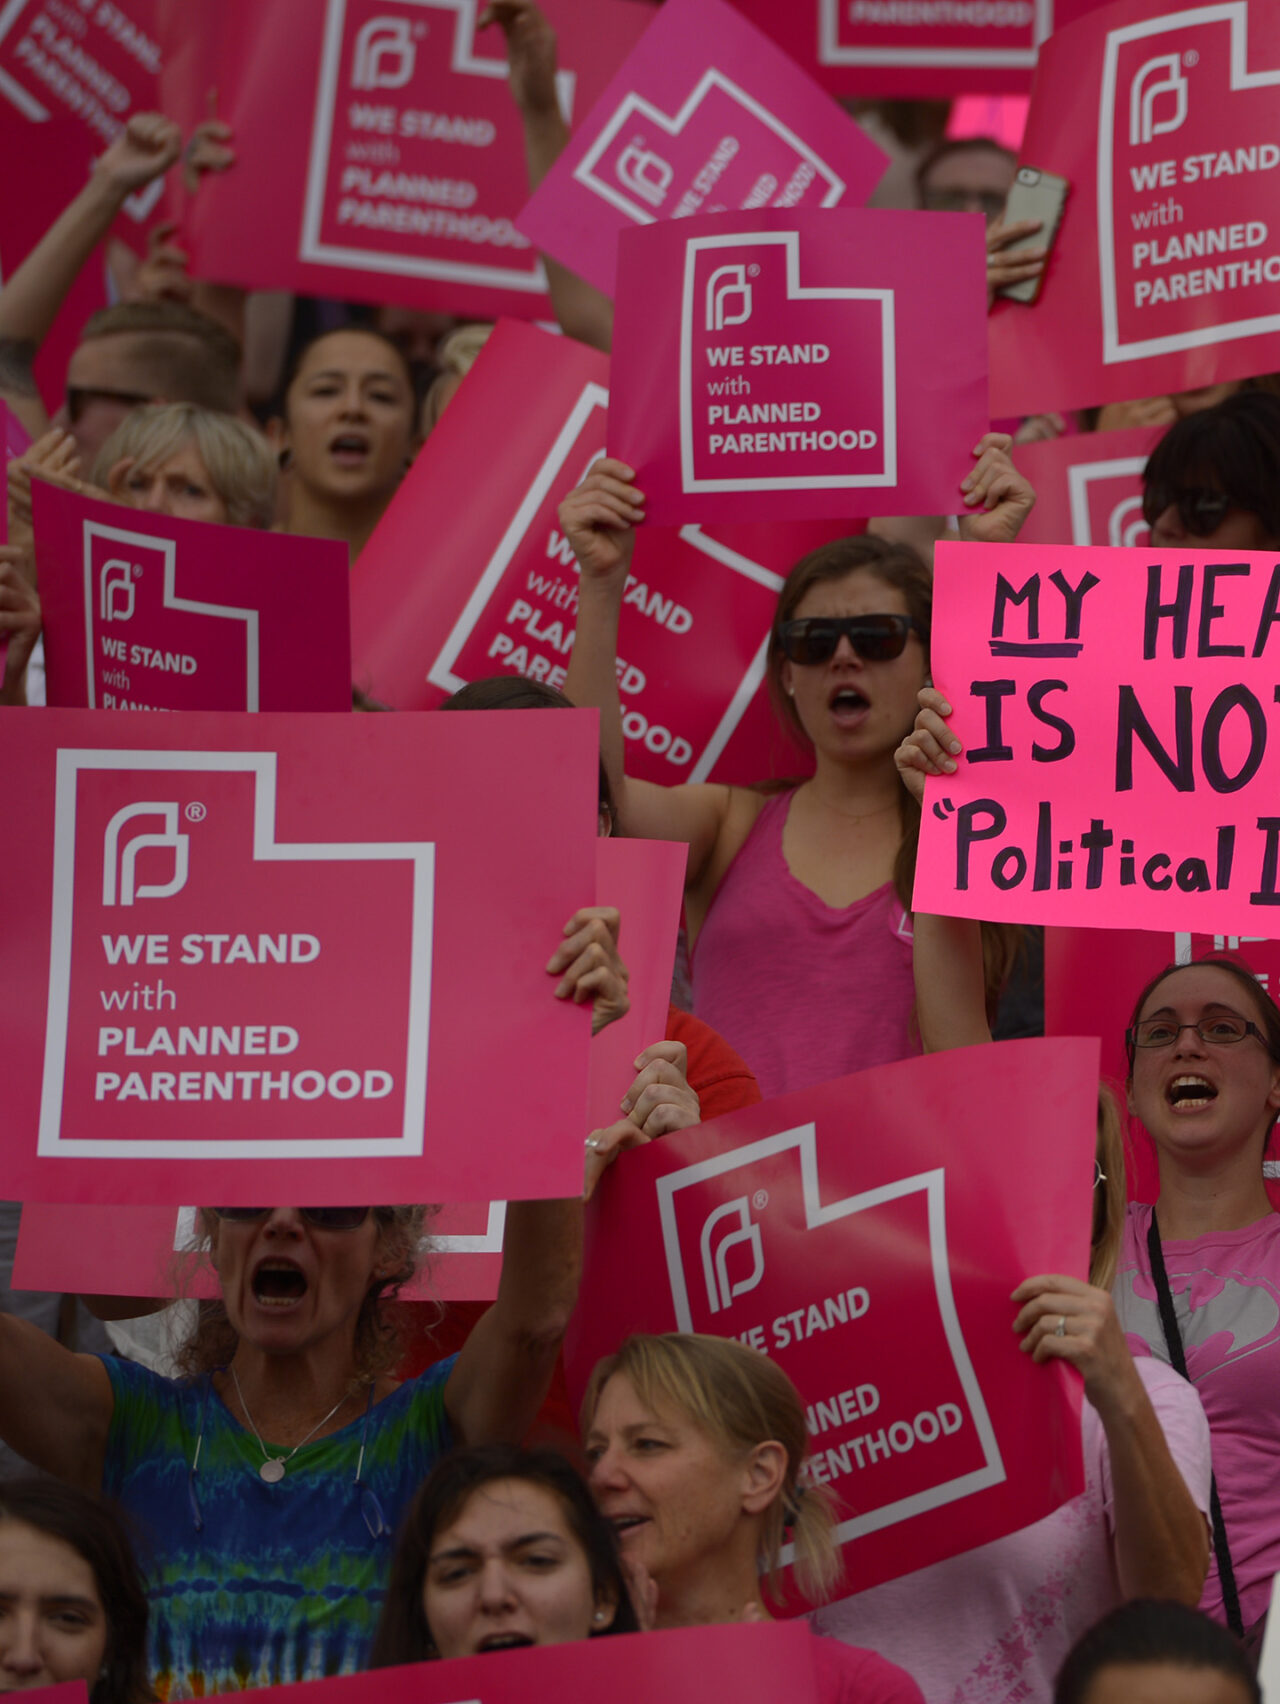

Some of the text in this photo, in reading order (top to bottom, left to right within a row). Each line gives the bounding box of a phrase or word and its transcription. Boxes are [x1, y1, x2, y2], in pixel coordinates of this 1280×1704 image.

[850, 0, 1034, 27] PARENTHOOD
[30, 13, 131, 112] PLANNED
[14, 35, 127, 143] PARENTH
[349, 102, 497, 147] WE STAND
[345, 140, 400, 166] with
[693, 136, 740, 196] STAND
[1131, 144, 1280, 191] WE STAND
[341, 165, 478, 209] PLANNED
[1131, 198, 1183, 230] with
[1133, 221, 1268, 268] PLANNED
[706, 344, 830, 368] WE STAND
[707, 375, 751, 397] with
[708, 402, 821, 425] PLANNED
[708, 429, 878, 454] PARENTHOOD
[990, 569, 1101, 641] MY
[102, 636, 198, 675] WE STAND
[102, 668, 130, 691] with
[966, 679, 1075, 764] IS
[101, 933, 321, 965] WE STAND
[100, 979, 177, 1011] with
[97, 1026, 300, 1056] PLANNED
[95, 1070, 394, 1100] PARENTHOOD
[772, 1286, 870, 1349] STAND
